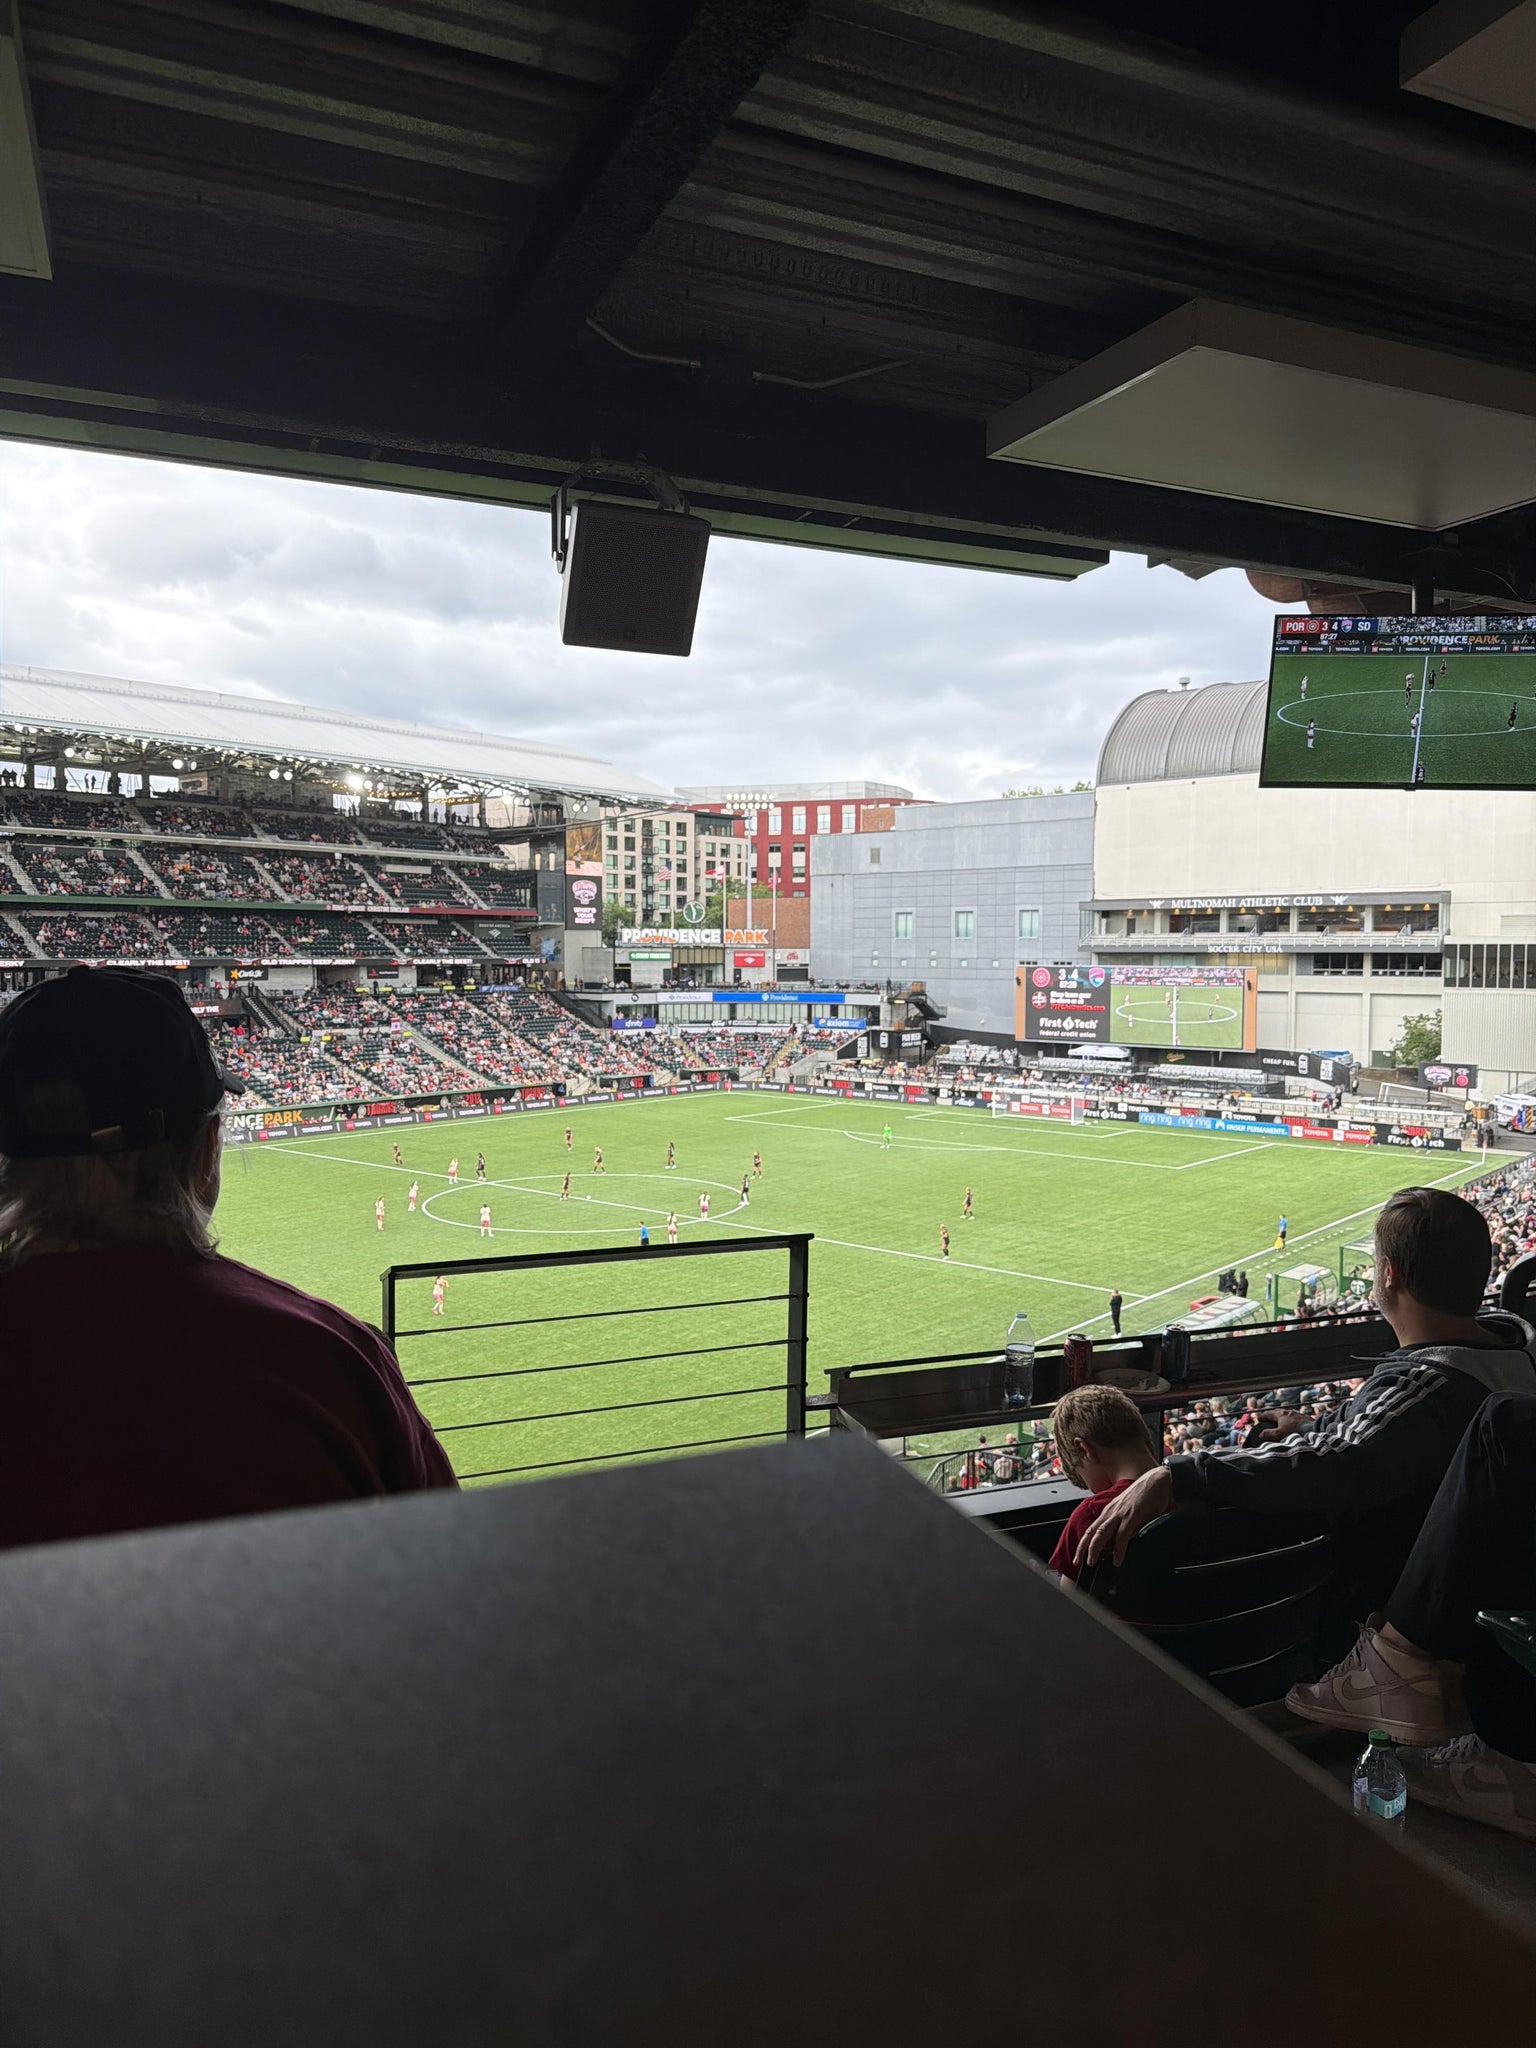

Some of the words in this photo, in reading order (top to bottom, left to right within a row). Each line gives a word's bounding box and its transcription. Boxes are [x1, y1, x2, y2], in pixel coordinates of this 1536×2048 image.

[1286, 622, 1305, 632] POR
[1321, 621, 1329, 631] 3
[1331, 621, 1338, 631] 4
[1357, 621, 1371, 631] SD
[1469, 635, 1500, 644] PARK
[1171, 899, 1236, 909] MULTNOMAH
[1239, 897, 1289, 907] ATHLETIC
[1293, 896, 1323, 906] CLUB
[621, 928, 721, 944] PROVIDENCE
[724, 929, 769, 944] PARK
[1208, 945, 1239, 953] SOCCER
[1242, 945, 1262, 953] CITY
[1265, 945, 1283, 953] USA
[1059, 969, 1066, 980] 3
[1071, 969, 1078, 980] 4
[1040, 1018, 1061, 1027] First
[1074, 1019, 1096, 1029] Tech
[1262, 1057, 1281, 1065] CHEAP
[264, 1110, 303, 1125] PARK
[1083, 1108, 1099, 1117] First
[1110, 1110, 1127, 1119] Tech
[1140, 1113, 1155, 1123] ring
[384, 1116, 413, 1124] TOYOTA.COM
[1157, 1114, 1172, 1125] ring
[1178, 1116, 1193, 1127] ring
[1195, 1118, 1211, 1129] ring
[302, 1125, 333, 1133] TOYOTA.COM
[1226, 1124, 1245, 1132] KAISER
[1304, 1129, 1328, 1137] TOYOTA
[1345, 1133, 1370, 1141] TOYOTA
